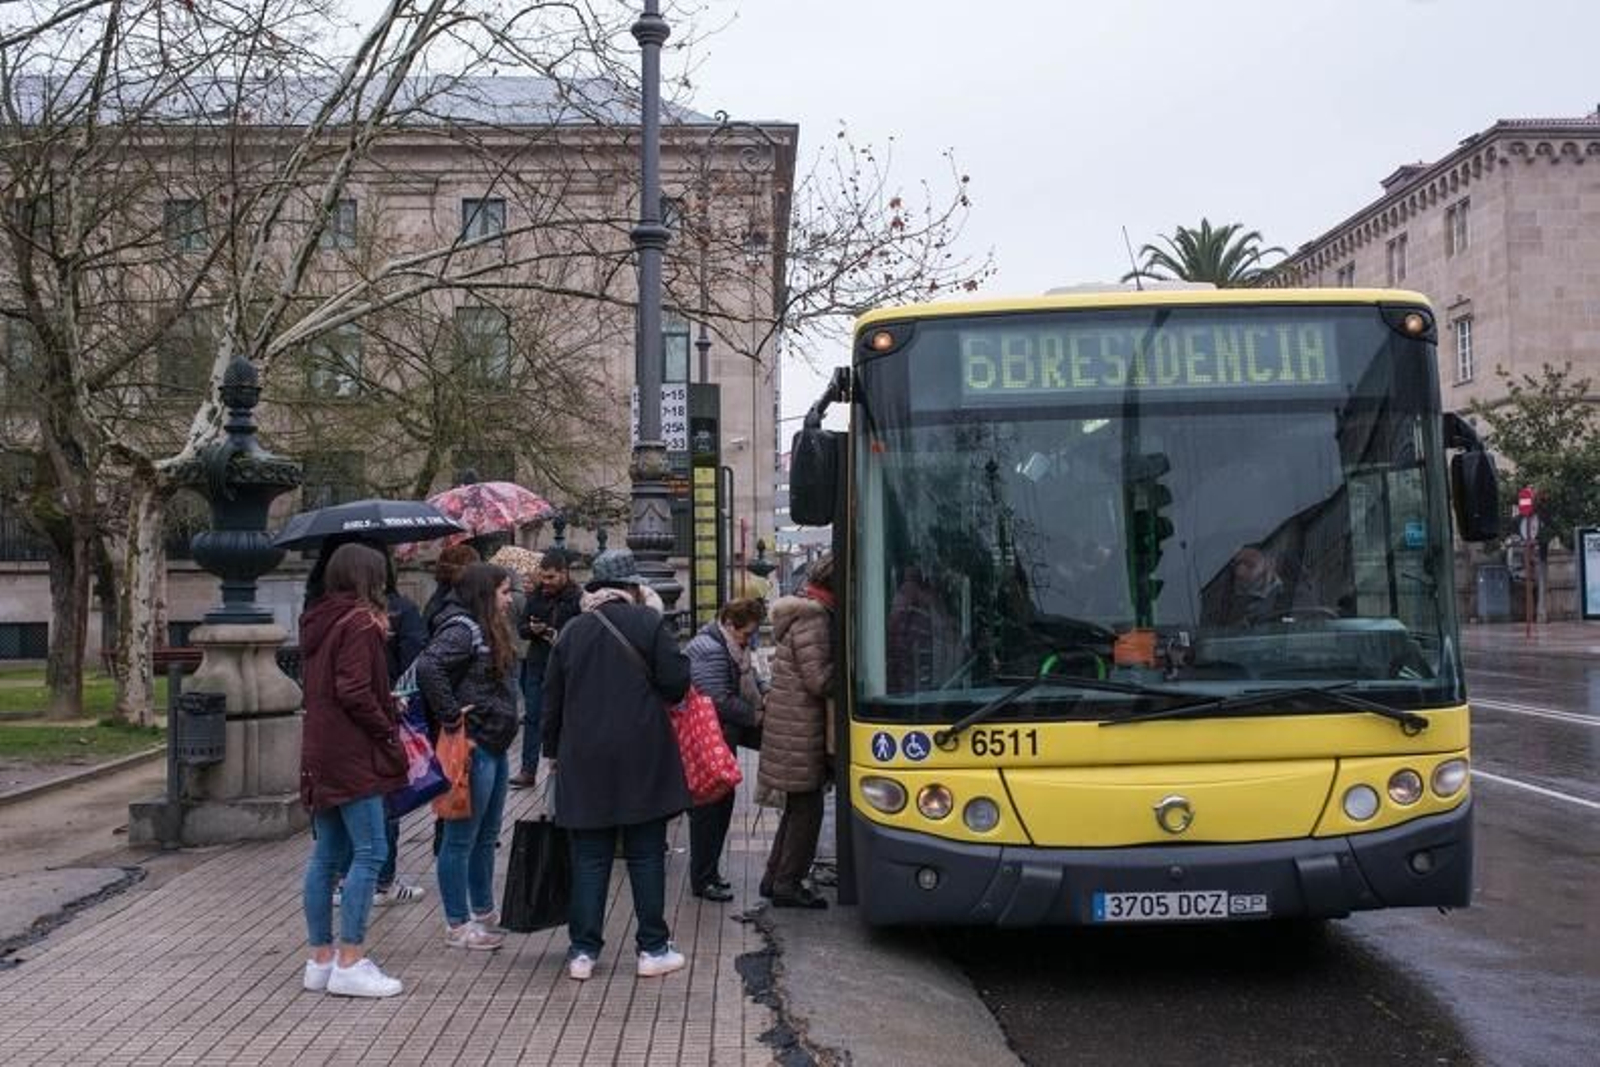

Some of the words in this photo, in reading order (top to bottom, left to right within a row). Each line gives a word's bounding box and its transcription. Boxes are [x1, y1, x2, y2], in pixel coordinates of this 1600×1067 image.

[971, 729, 1038, 756] 6511
[1110, 895, 1170, 918] 3705
[1178, 893, 1223, 916] DCZ
[1232, 896, 1264, 912] SP
